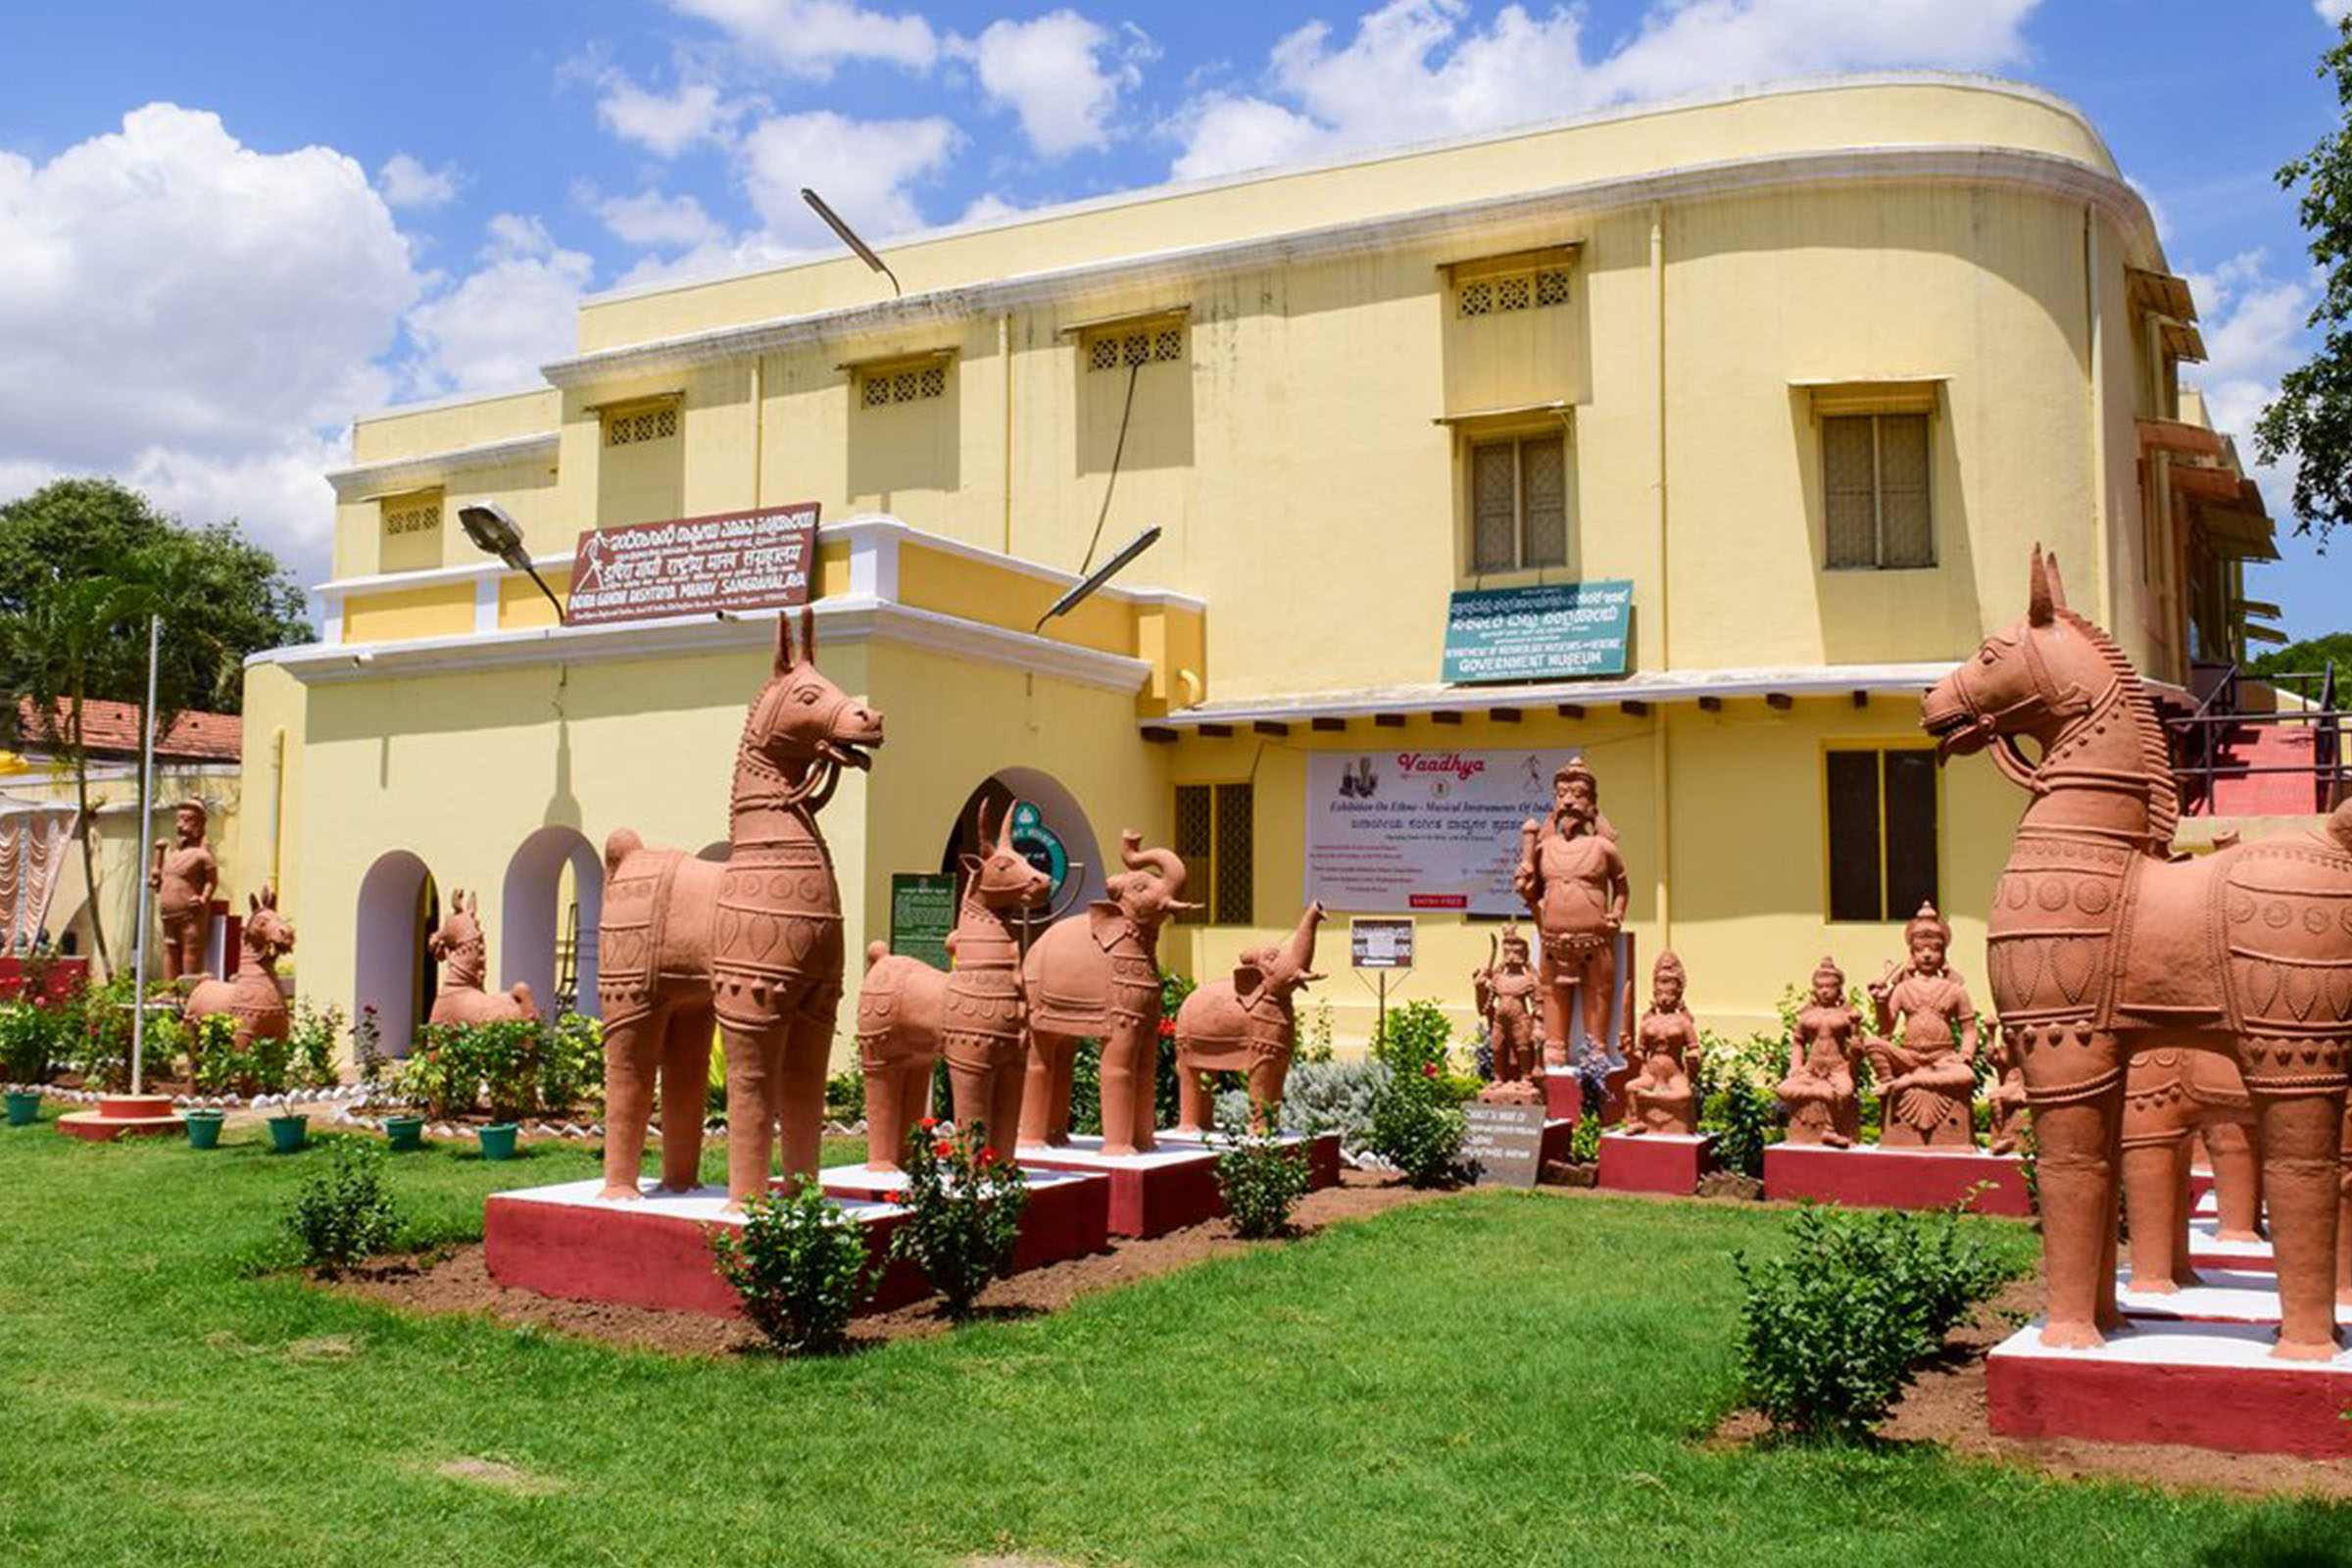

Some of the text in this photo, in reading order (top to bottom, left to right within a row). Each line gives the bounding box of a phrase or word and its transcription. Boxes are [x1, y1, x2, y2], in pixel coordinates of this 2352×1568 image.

[1459, 655, 1544, 672] GOVERNMENT
[1547, 651, 1602, 667] MUSEUM
[1397, 753, 1486, 781] Vaadhya
[1376, 801, 1390, 812] On
[1426, 802, 1461, 812] Musical
